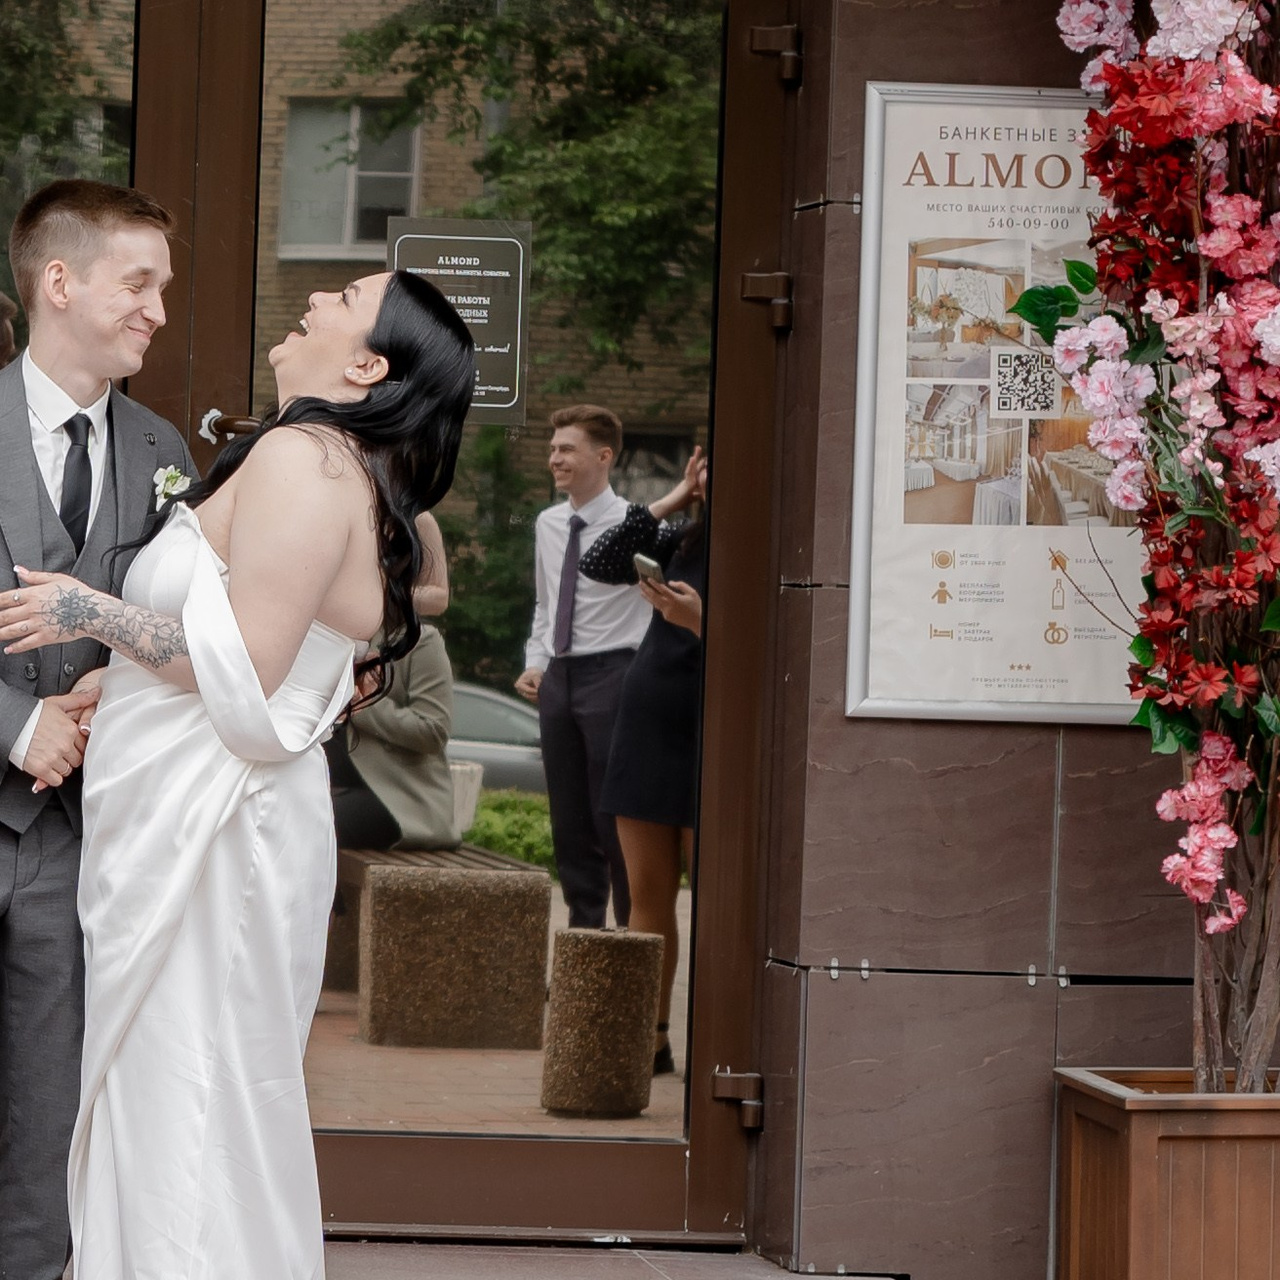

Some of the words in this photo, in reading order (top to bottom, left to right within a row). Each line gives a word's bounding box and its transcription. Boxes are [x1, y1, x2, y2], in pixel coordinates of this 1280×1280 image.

[939, 126, 1058, 142] БАНКЕТНЫЕ
[902, 151, 1093, 190] ALMO
[926, 203, 963, 213] МЕСТО
[968, 204, 1006, 213] ВАШИХ
[1010, 205, 1081, 214] СЧАСТЛИВЫХ
[987, 218, 1070, 230] 540-09-00
[437, 256, 480, 266] ALMOND
[457, 296, 490, 305] РАБОТЫ
